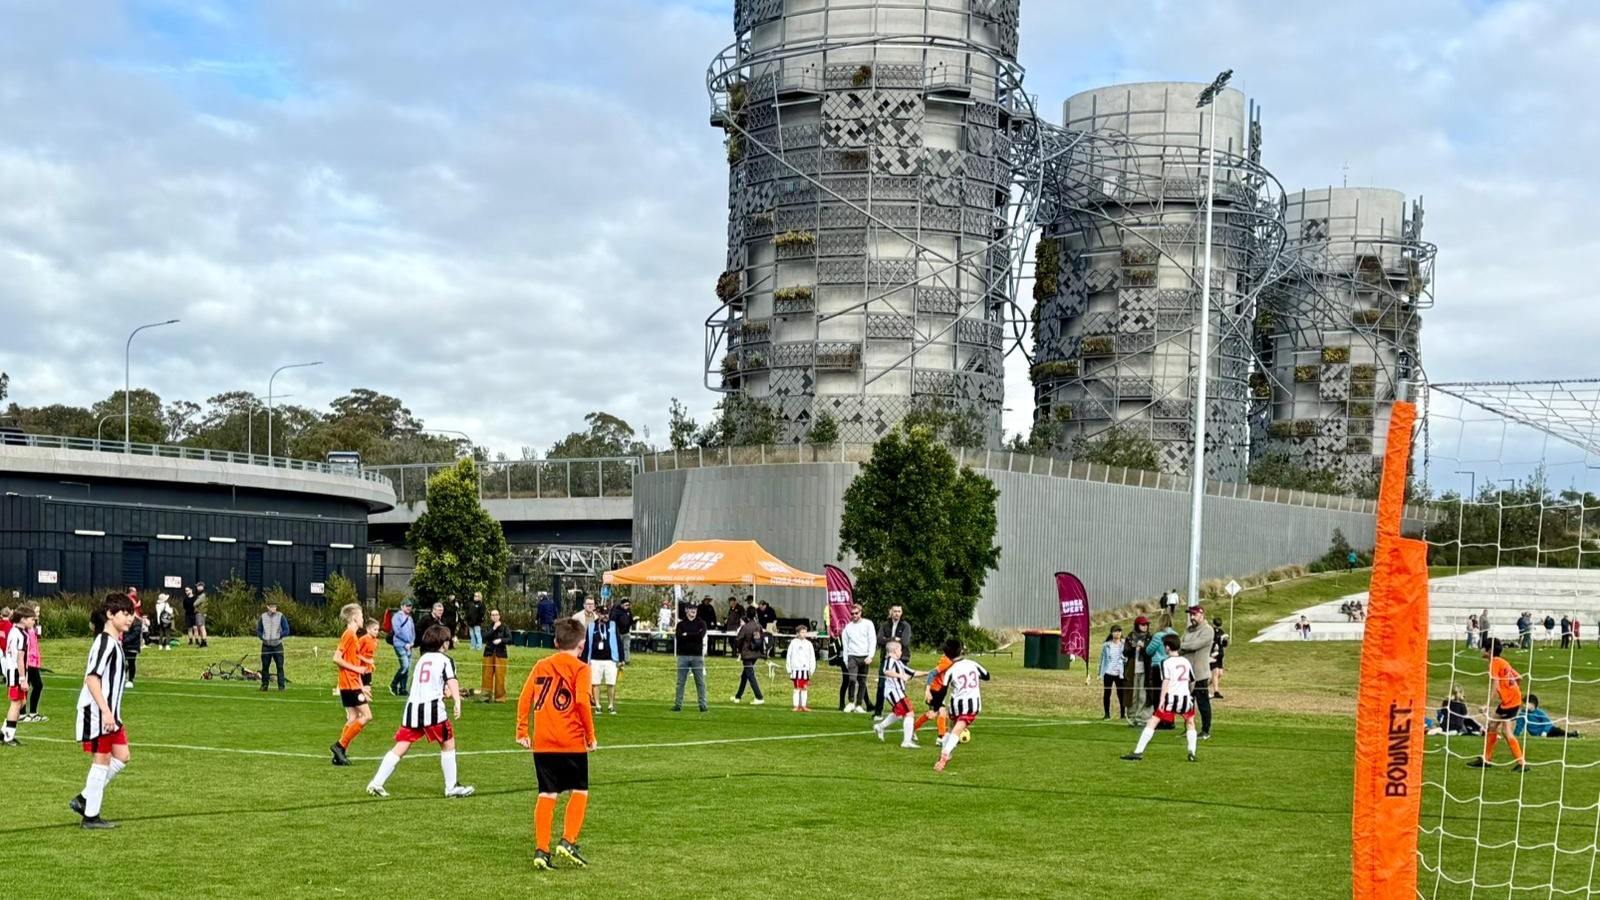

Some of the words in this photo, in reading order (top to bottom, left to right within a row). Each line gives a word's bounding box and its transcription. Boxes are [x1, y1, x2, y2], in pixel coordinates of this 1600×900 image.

[1062, 605, 1084, 614] WEST
[419, 661, 432, 683] 6
[957, 671, 978, 692] 23
[1176, 665, 1189, 682] 2
[534, 676, 572, 711] 76
[1385, 703, 1411, 797] BOWNET
